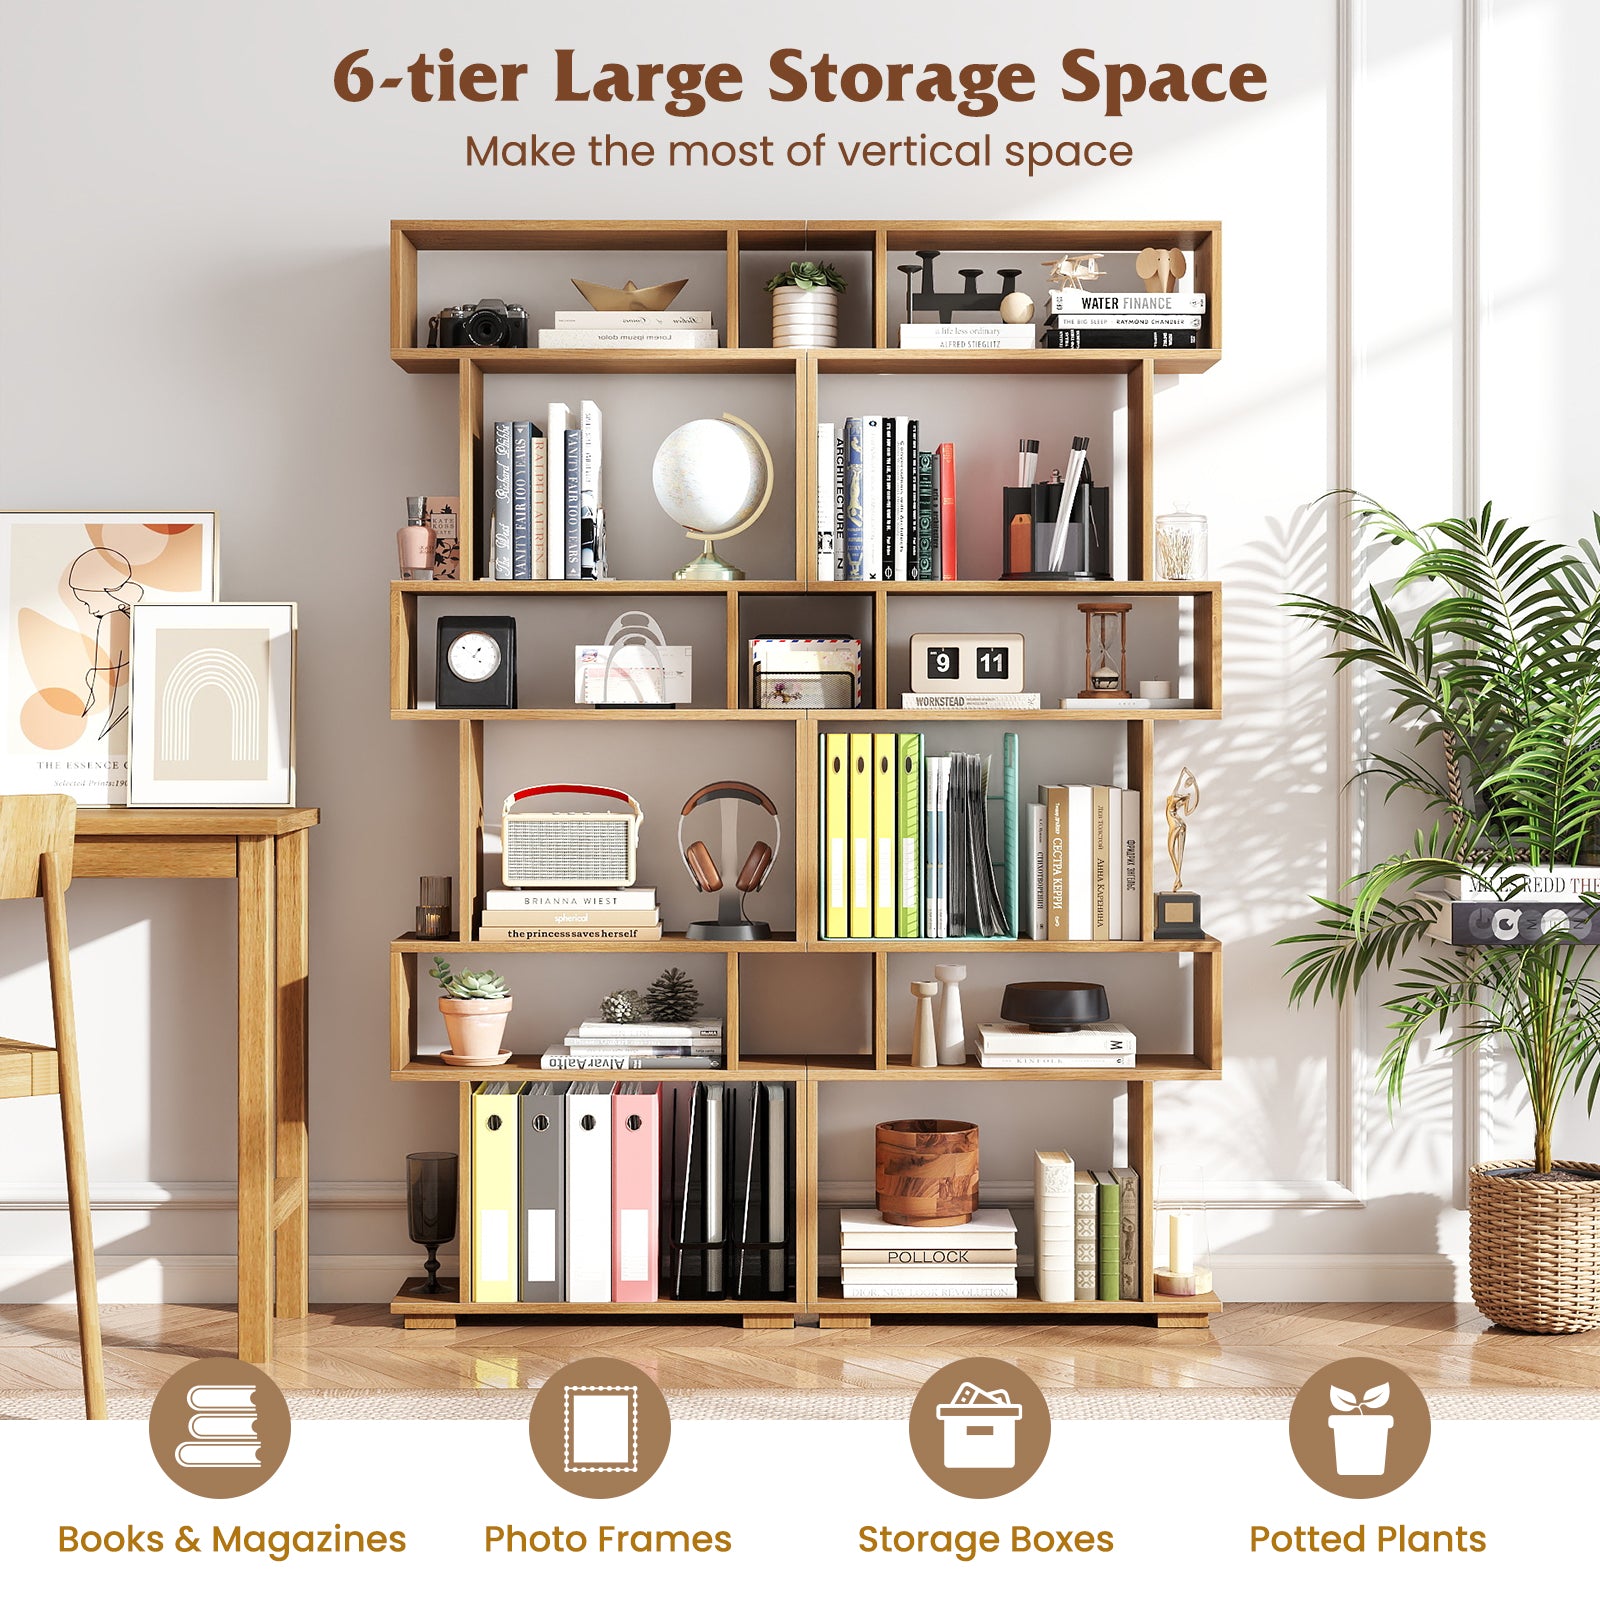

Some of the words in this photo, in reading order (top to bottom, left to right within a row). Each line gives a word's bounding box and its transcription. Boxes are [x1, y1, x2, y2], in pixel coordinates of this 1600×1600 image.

[1081, 297, 1119, 310] WATER
[1123, 297, 1172, 310] FINANCE
[969, 327, 1000, 337] ordinary
[515, 438, 526, 475] YEARS
[568, 432, 578, 472] VANITY
[568, 476, 578, 503] FAIR
[836, 437, 844, 540] ARCHITECTURE
[515, 504, 526, 530] FAIR
[515, 535, 526, 577] VANITY
[568, 528, 578, 564] YEARS
[936, 653, 950, 673] 9
[979, 653, 1003, 673] 11
[915, 696, 965, 707] WORKSTEAD
[37, 761, 61, 770] THE
[67, 761, 119, 770] ESSENCE
[1052, 836, 1063, 876] СЕСТРА
[1126, 839, 1136, 867] ФРИДРИХ
[1126, 867, 1136, 892] ЭНГЕЛЬС
[1523, 876, 1566, 893] REDD
[524, 897, 578, 906] BRIANNA
[583, 897, 618, 906] WIEST
[1052, 877, 1063, 911] КЕРРИ
[554, 913, 589, 924] spherical
[508, 929, 525, 938] the
[526, 929, 571, 940] princess
[600, 929, 638, 938] herself
[887, 1250, 969, 1264] POLLOCK
[883, 1288, 907, 1297] NEW
[909, 1288, 939, 1297] LOOK
[941, 1288, 1009, 1297] REVOLUTION
